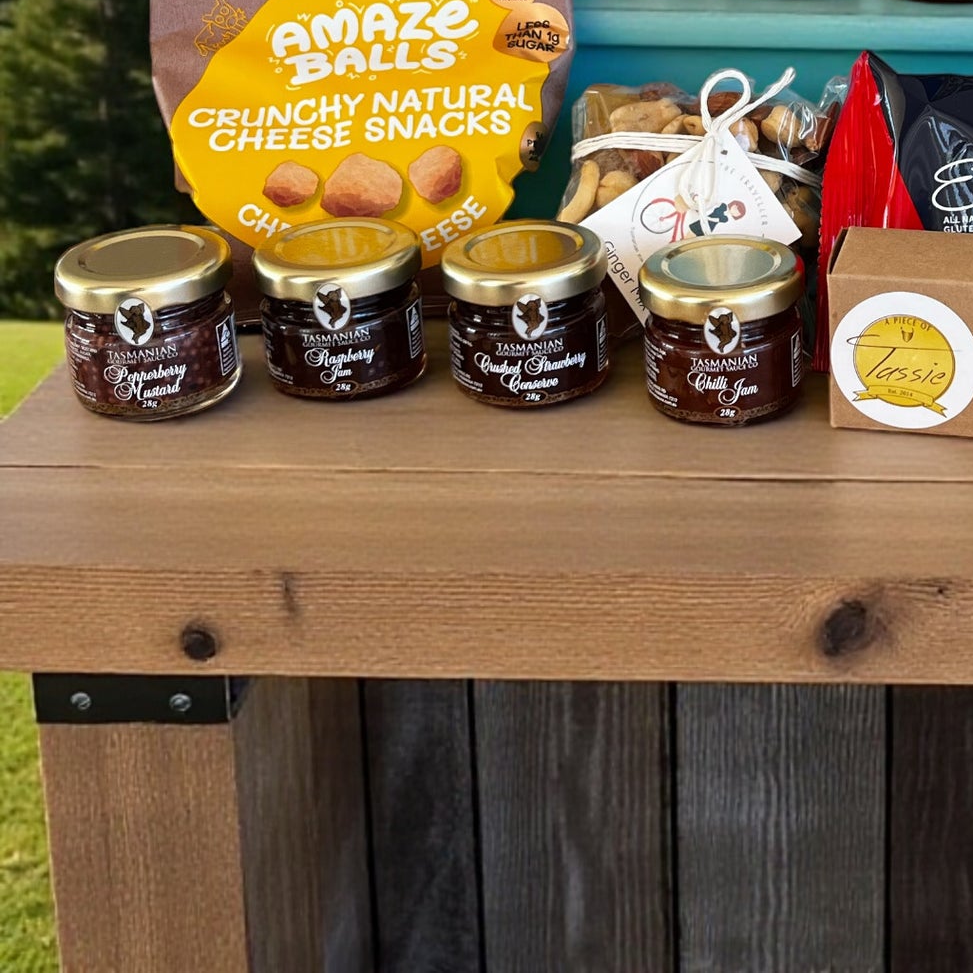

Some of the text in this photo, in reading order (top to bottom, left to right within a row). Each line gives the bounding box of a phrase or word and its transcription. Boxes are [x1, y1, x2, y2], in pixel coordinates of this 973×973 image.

[505, 30, 560, 45] THAN 1g
[507, 39, 556, 53] SUGAR
[284, 40, 458, 85] BALLS
[188, 83, 534, 129] CRUNCHY NATURAL
[208, 109, 512, 152] CHEESE SNACKS
[943, 215, 960, 225] ALL
[604, 241, 634, 284] Ginger
[894, 317, 916, 327] PIECE
[920, 322, 932, 332] OF
[302, 327, 370, 343] TASMANIAN
[107, 343, 177, 360] TASMANIAN
[496, 337, 564, 352] TASMANIAN
[304, 347, 375, 369] Raspberry
[474, 351, 587, 375] Crushed Strawberry
[690, 354, 757, 367] TASMANIAN
[846, 334, 946, 385] Tassie
[104, 363, 187, 388] Pepperberry
[320, 367, 352, 384] Jam
[500, 373, 559, 395] Conserve
[114, 381, 180, 401] Mustard
[336, 383, 351, 391] 28g
[687, 371, 758, 405] Chilli Jam
[141, 399, 158, 409] 28g
[525, 393, 540, 401] 28g
[720, 409, 735, 417] 28g
